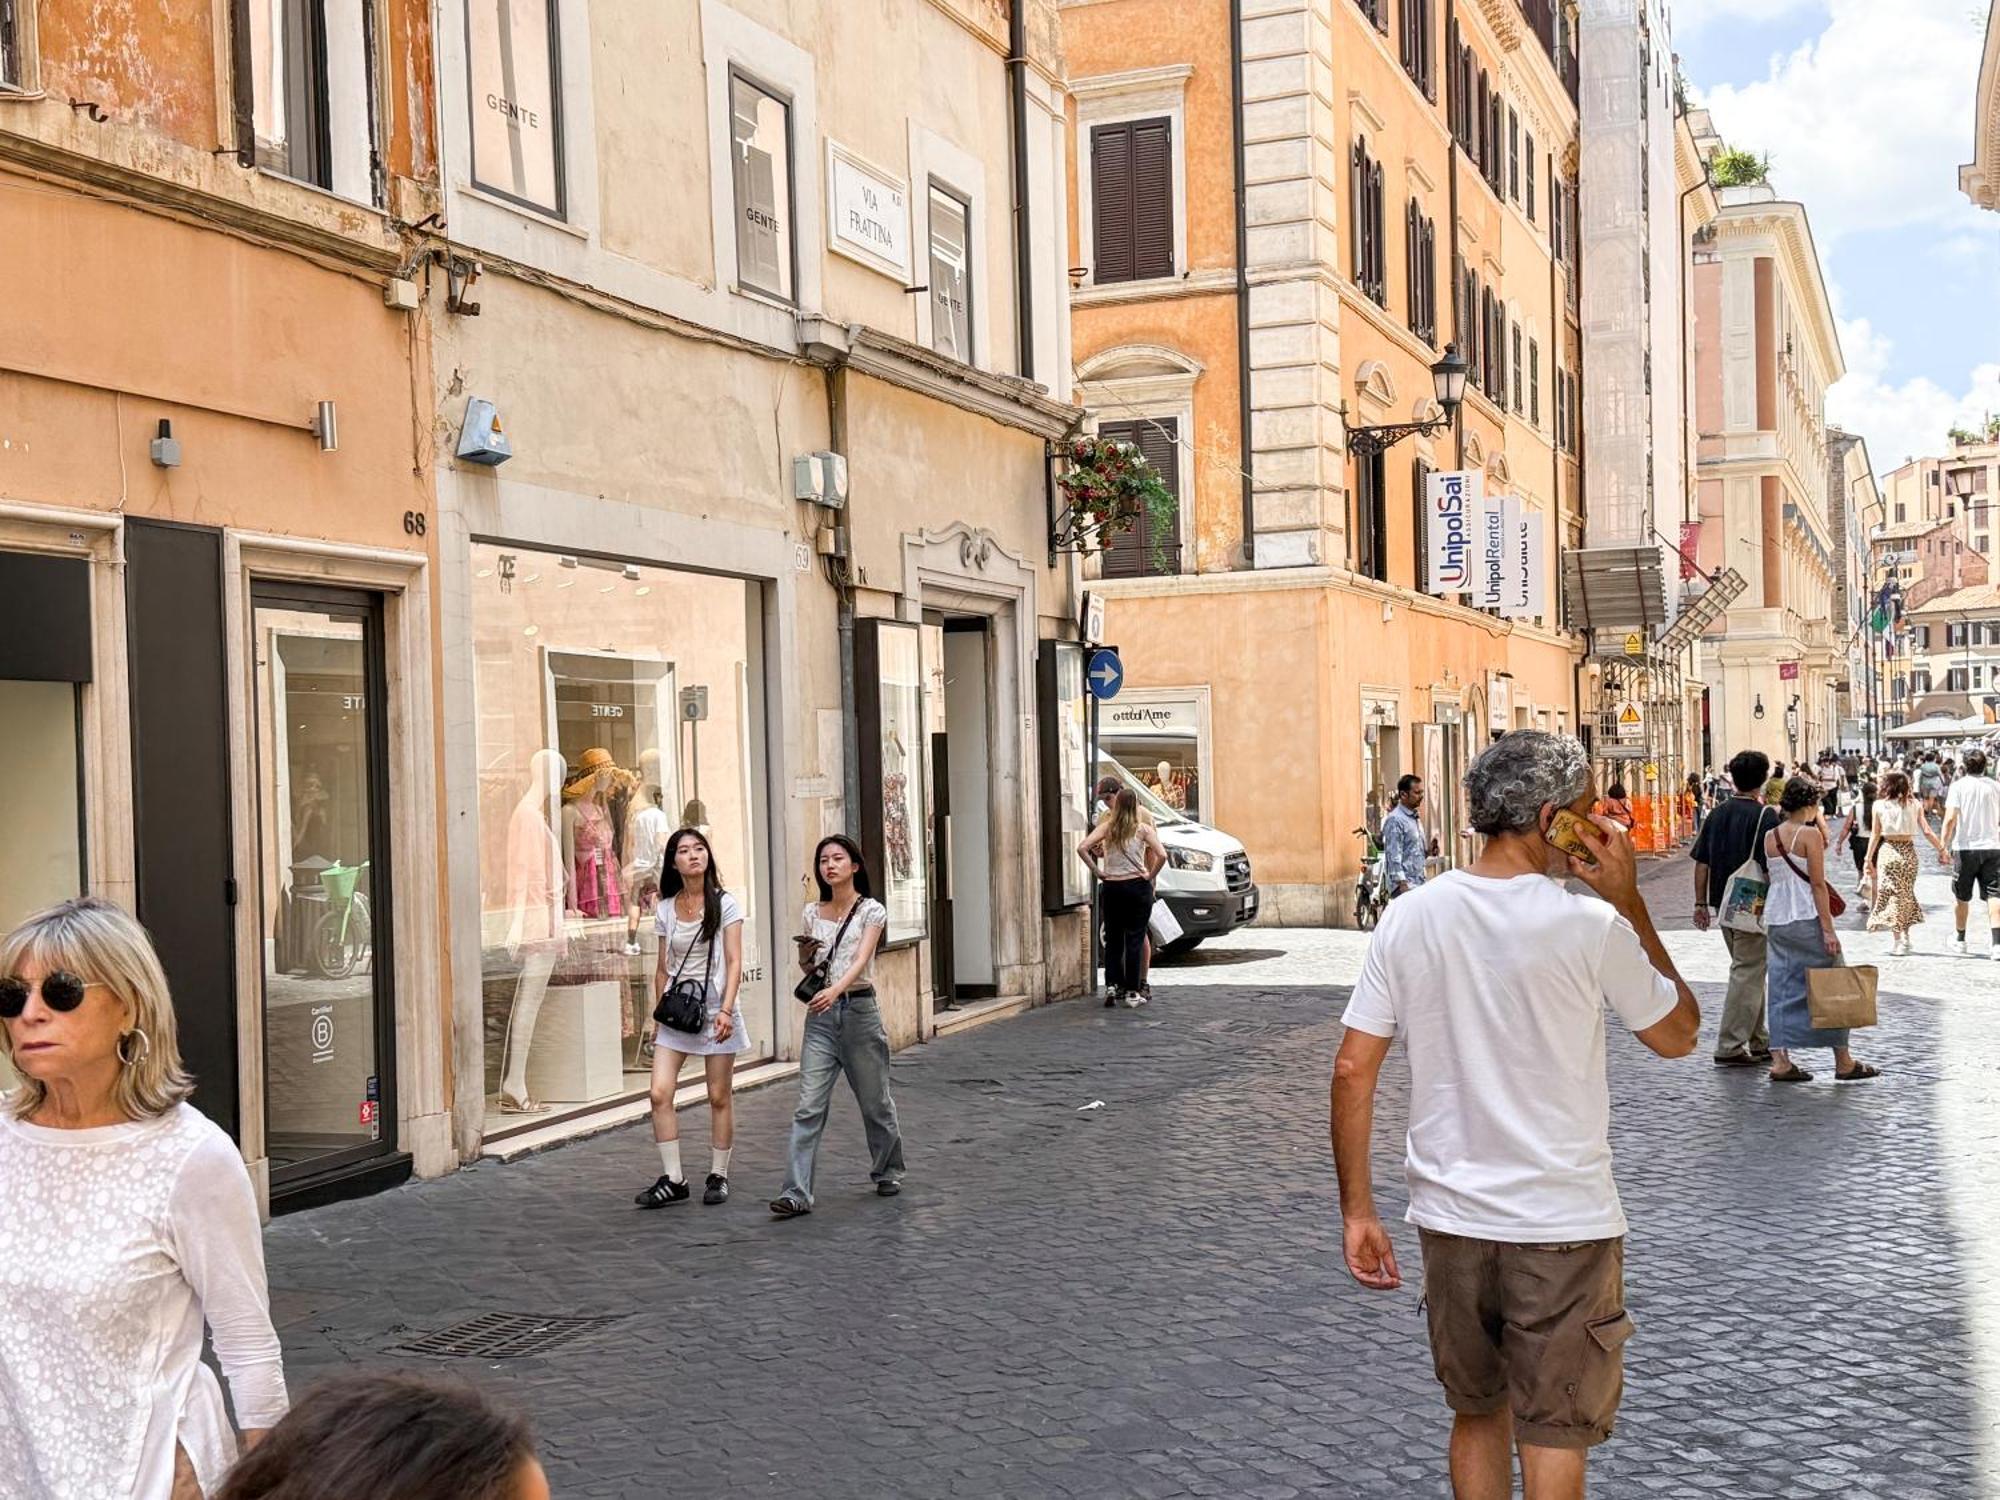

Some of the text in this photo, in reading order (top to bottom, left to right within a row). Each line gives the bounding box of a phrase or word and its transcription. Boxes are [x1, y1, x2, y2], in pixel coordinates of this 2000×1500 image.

[487, 94, 538, 129] GENTE
[862, 186, 878, 212] VIA
[747, 208, 780, 233] GENTE
[850, 209, 893, 249] FRATTINA
[403, 510, 426, 537] 68
[1438, 476, 1471, 582] UnipolSai
[795, 546, 809, 569] 69
[1485, 511, 1505, 603] UnipolRental
